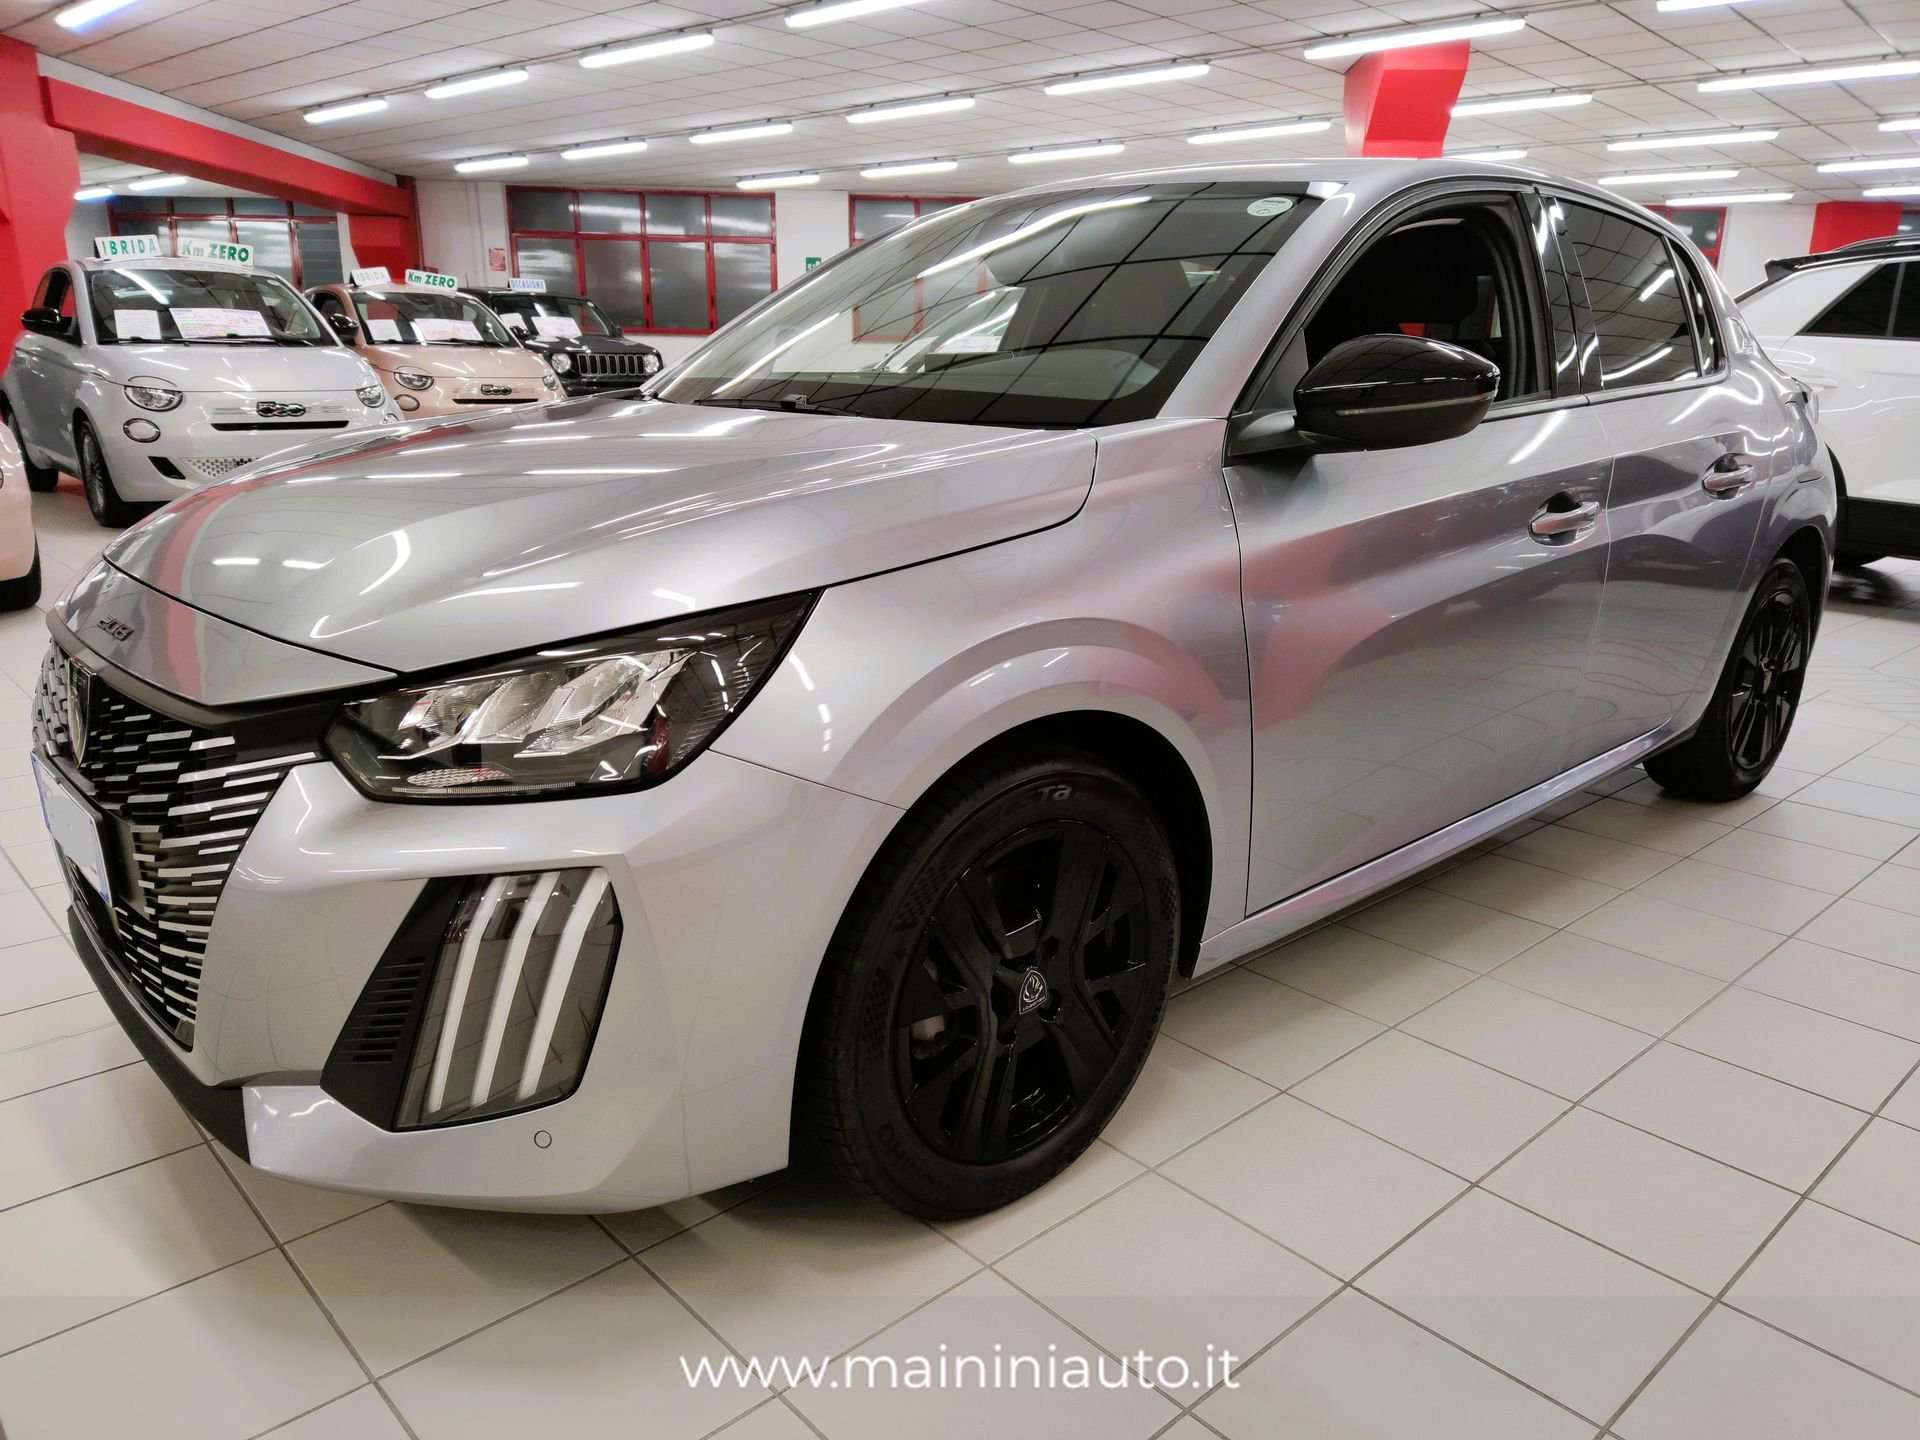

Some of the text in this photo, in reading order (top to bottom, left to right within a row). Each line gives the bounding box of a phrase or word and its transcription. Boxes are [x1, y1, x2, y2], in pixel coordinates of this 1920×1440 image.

[102, 238, 158, 256] IBRIDA
[182, 240, 250, 262] Km ZERO
[408, 272, 455, 289] Km ZERO
